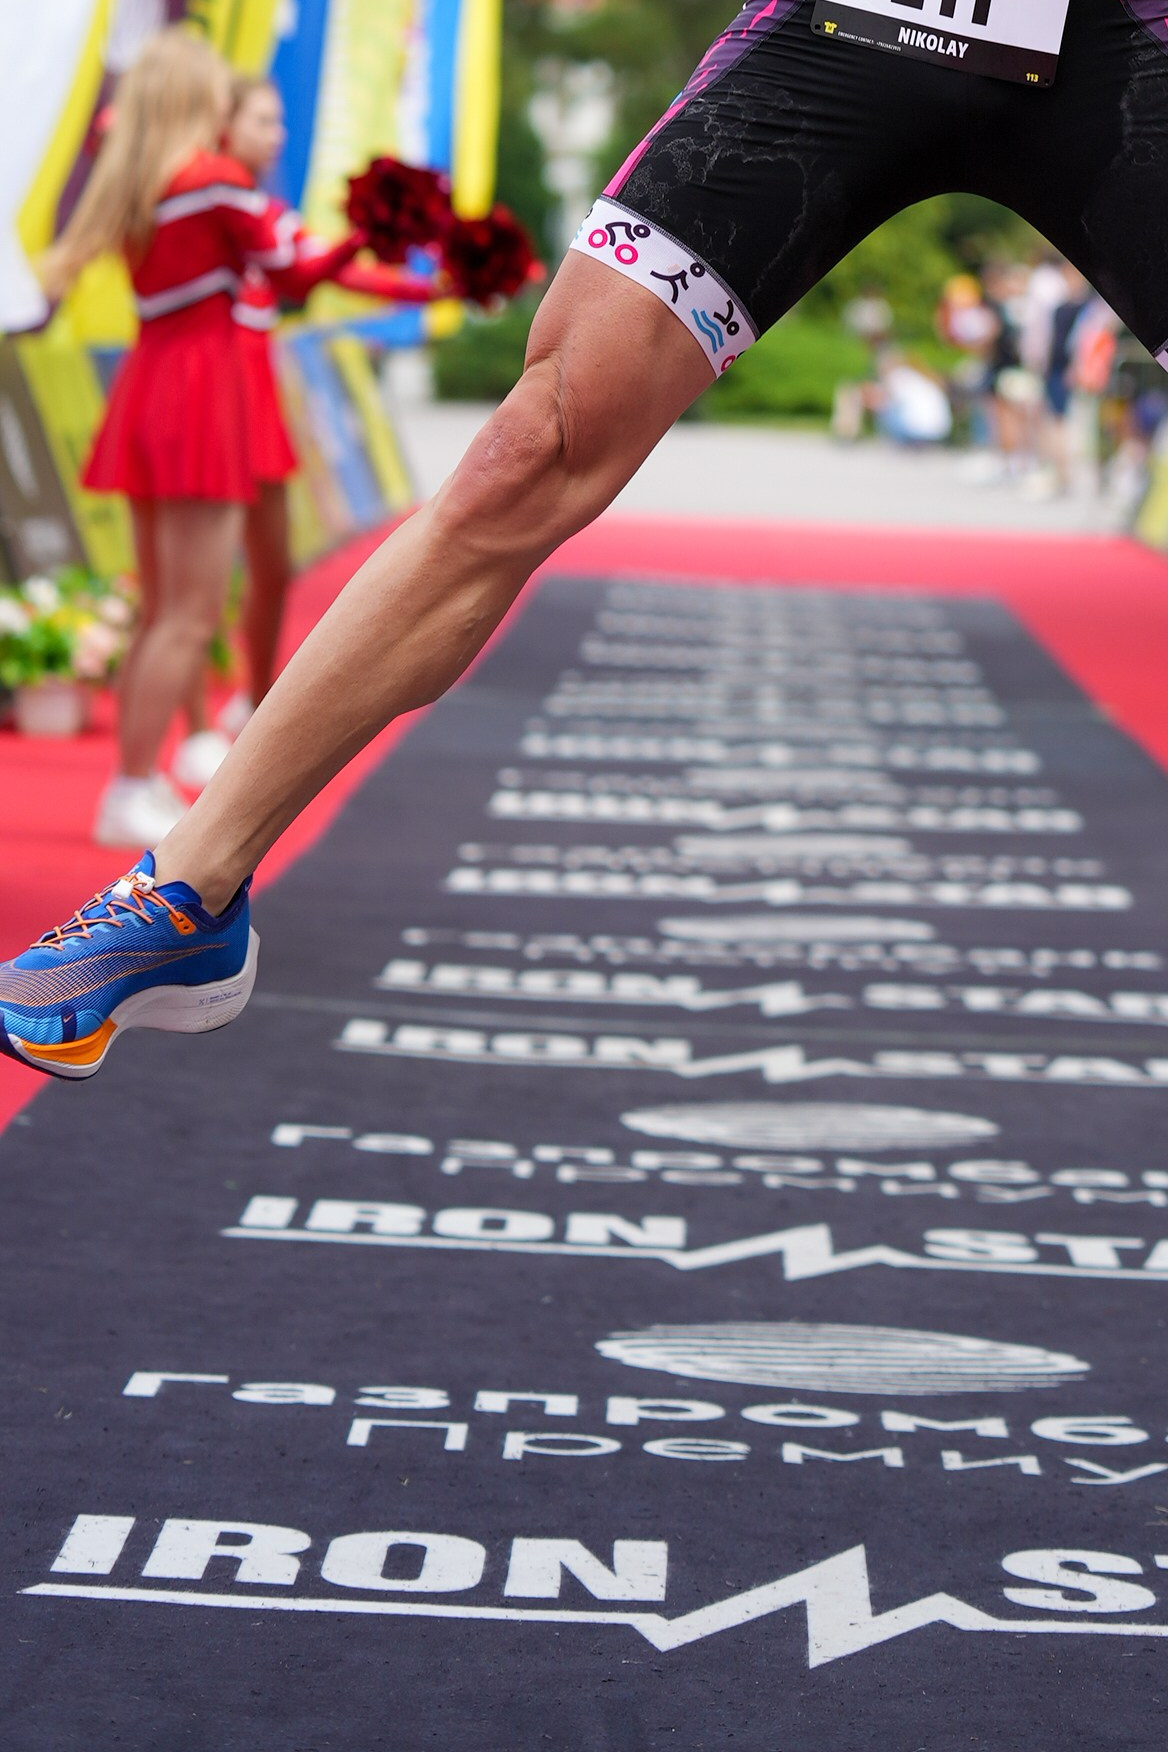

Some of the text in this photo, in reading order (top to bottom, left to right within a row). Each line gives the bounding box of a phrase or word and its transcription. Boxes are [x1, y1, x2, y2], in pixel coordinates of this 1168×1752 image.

[897, 26, 969, 59] NIKOLAY
[241, 1195, 686, 1249] IRON
[48, 1514, 670, 1602] IRON
